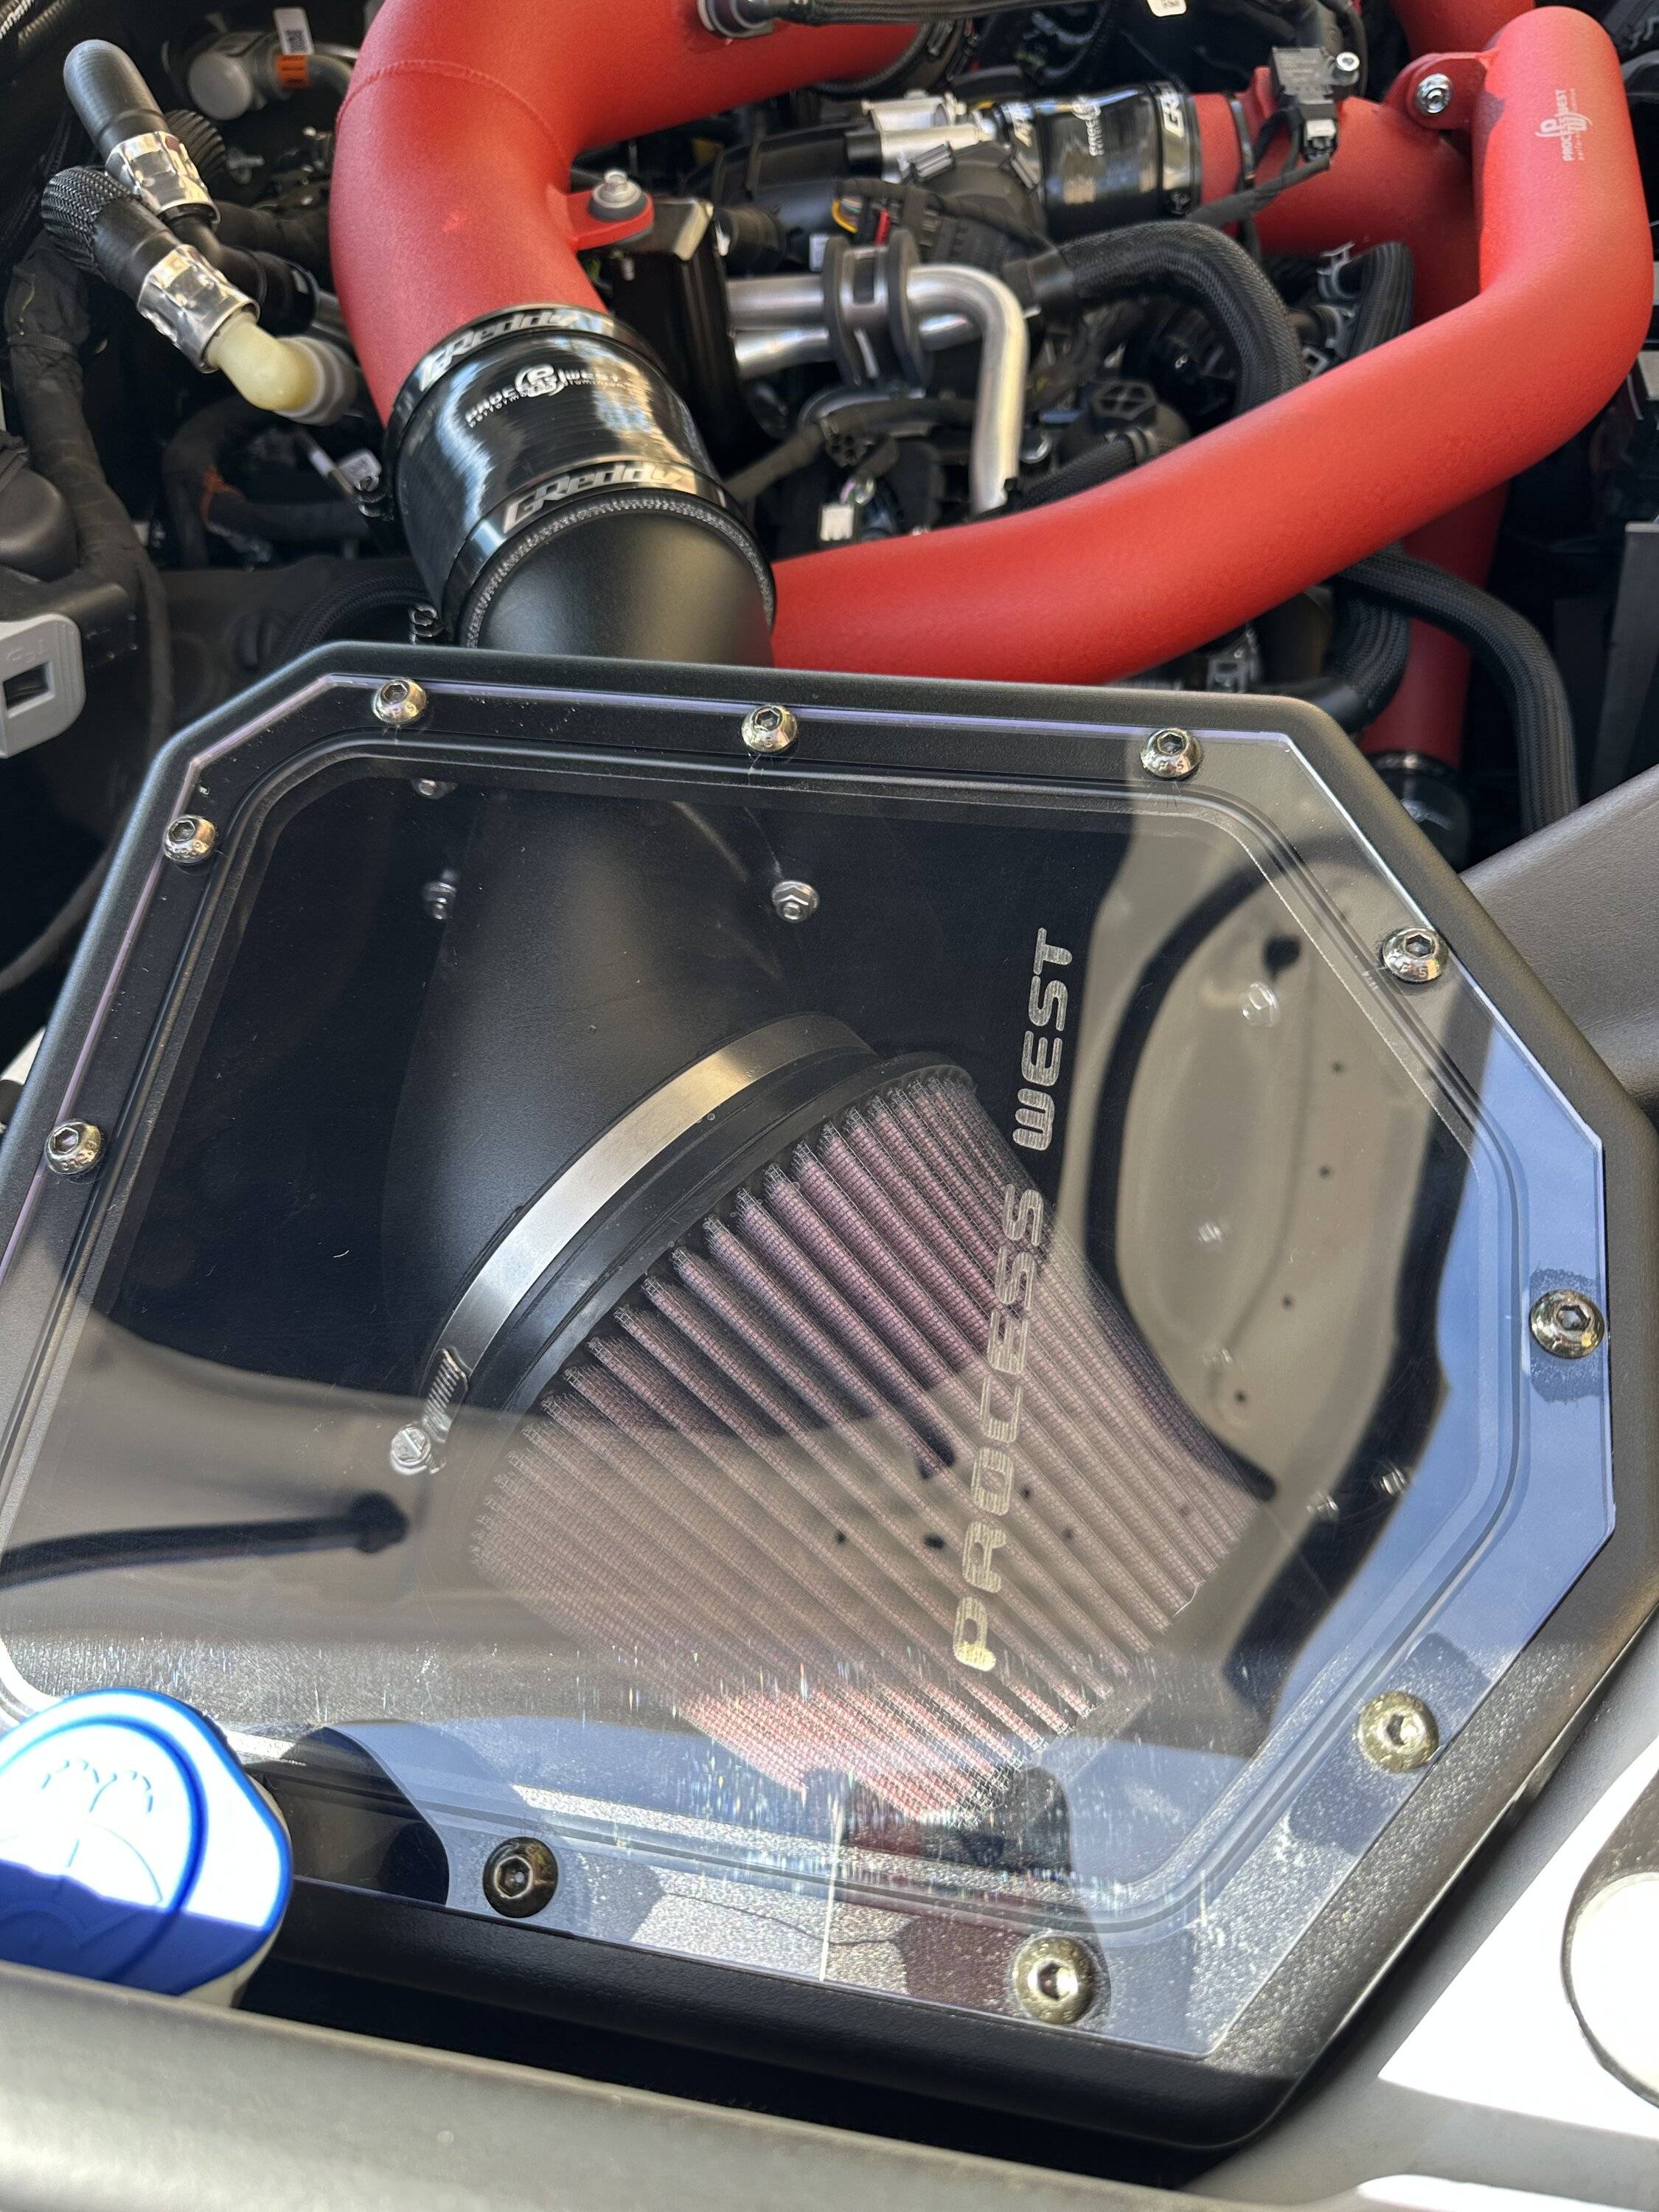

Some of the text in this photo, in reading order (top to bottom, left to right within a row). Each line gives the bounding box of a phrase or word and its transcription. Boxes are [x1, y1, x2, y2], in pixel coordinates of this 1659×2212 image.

[503, 463, 684, 534] GReddy
[953, 926, 1073, 1672] PROCESS WEST
